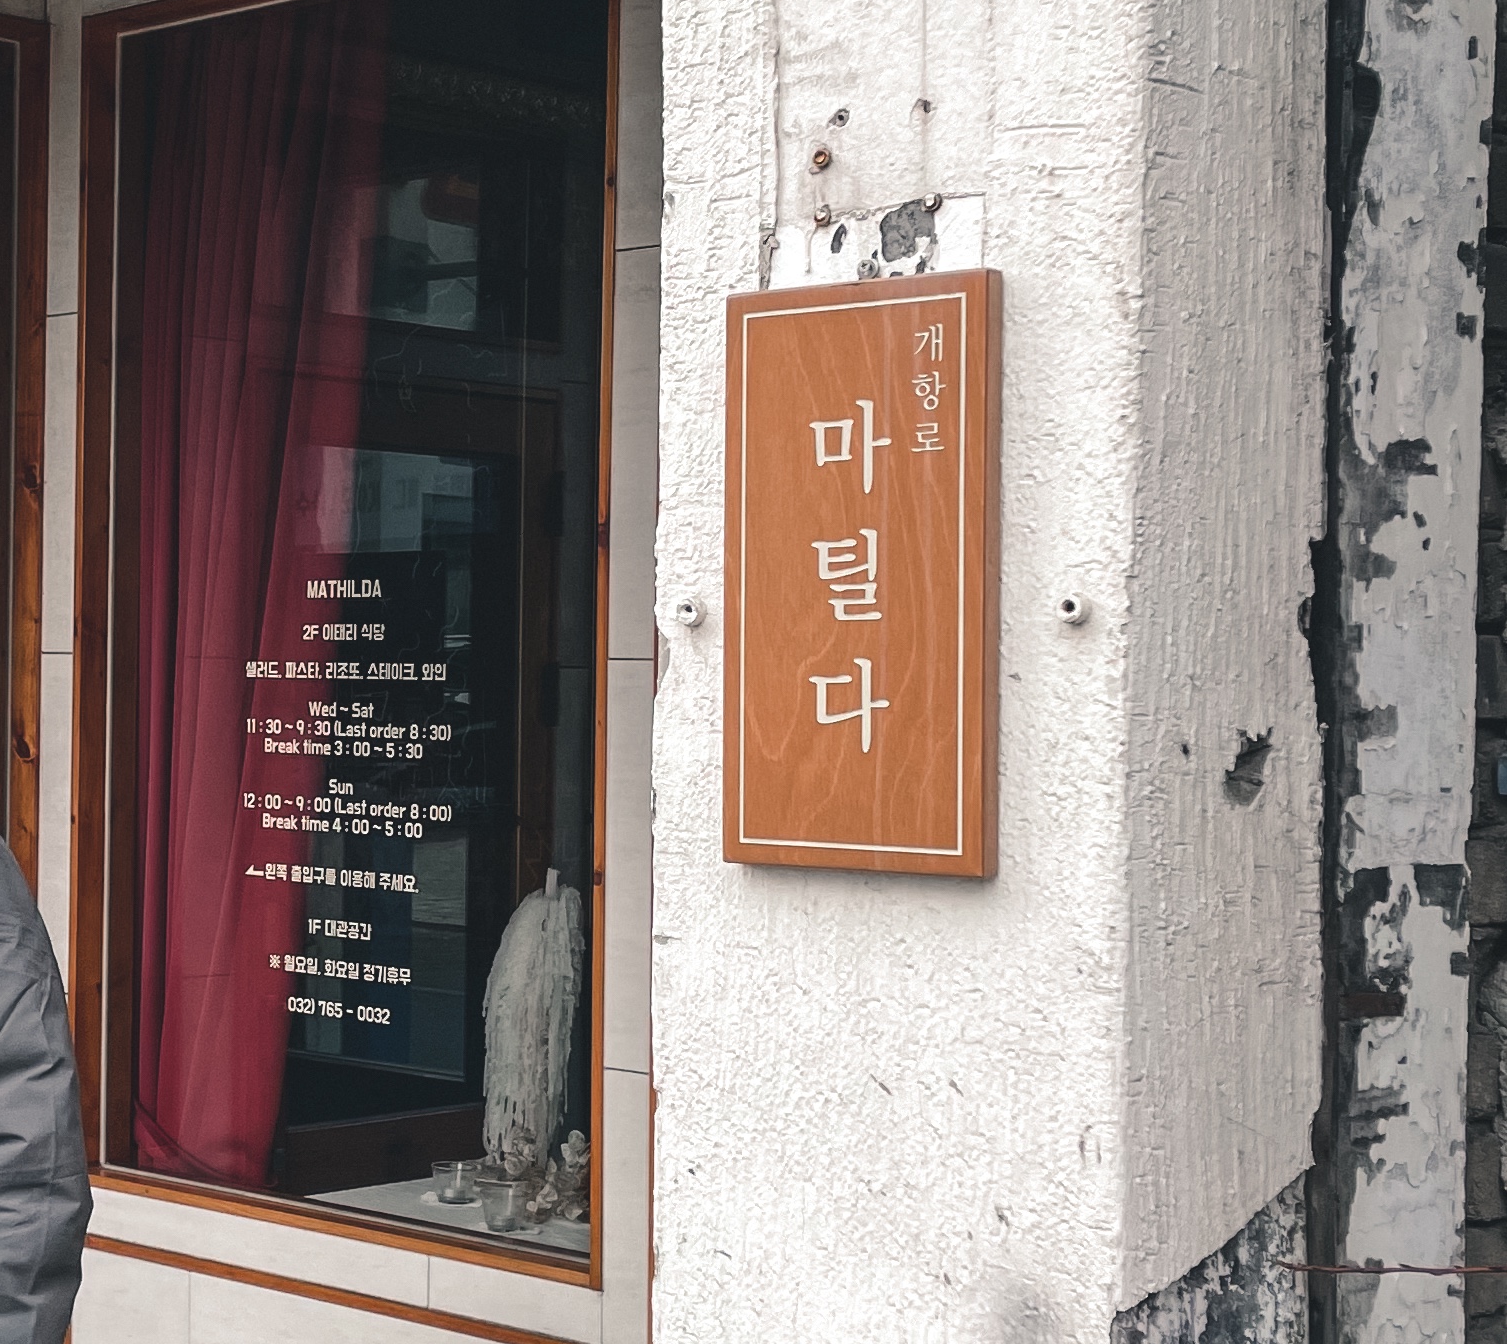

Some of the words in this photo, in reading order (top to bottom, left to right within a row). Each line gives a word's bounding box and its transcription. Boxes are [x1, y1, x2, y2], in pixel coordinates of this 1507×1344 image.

[910, 323, 947, 453] 개항로
[808, 399, 892, 754] 마틸다
[306, 579, 382, 599] MATHILDA
[302, 624, 320, 641] 2F
[322, 623, 358, 641] 이태리
[360, 623, 386, 641] 식당
[421, 663, 447, 681] 와인
[308, 700, 337, 717] Wed
[351, 702, 375, 719] Sat
[333, 719, 367, 738] (Last
[369, 722, 407, 739] order
[264, 737, 301, 755] Break
[302, 738, 332, 756] time
[328, 778, 354, 796] Sun
[333, 797, 367, 816] (Last
[369, 801, 407, 820] order
[262, 812, 299, 831] Break
[300, 815, 330, 833] time
[264, 862, 288, 882] 왼쪽
[290, 864, 337, 886] 출입구를
[340, 869, 376, 889] 이용해
[307, 918, 322, 935] 1F
[324, 919, 373, 941] 대관공간
[323, 958, 360, 980] 화요일
[362, 963, 412, 986] 정기휴무
[287, 996, 316, 1015] 032)
[357, 1005, 391, 1025] 0032
